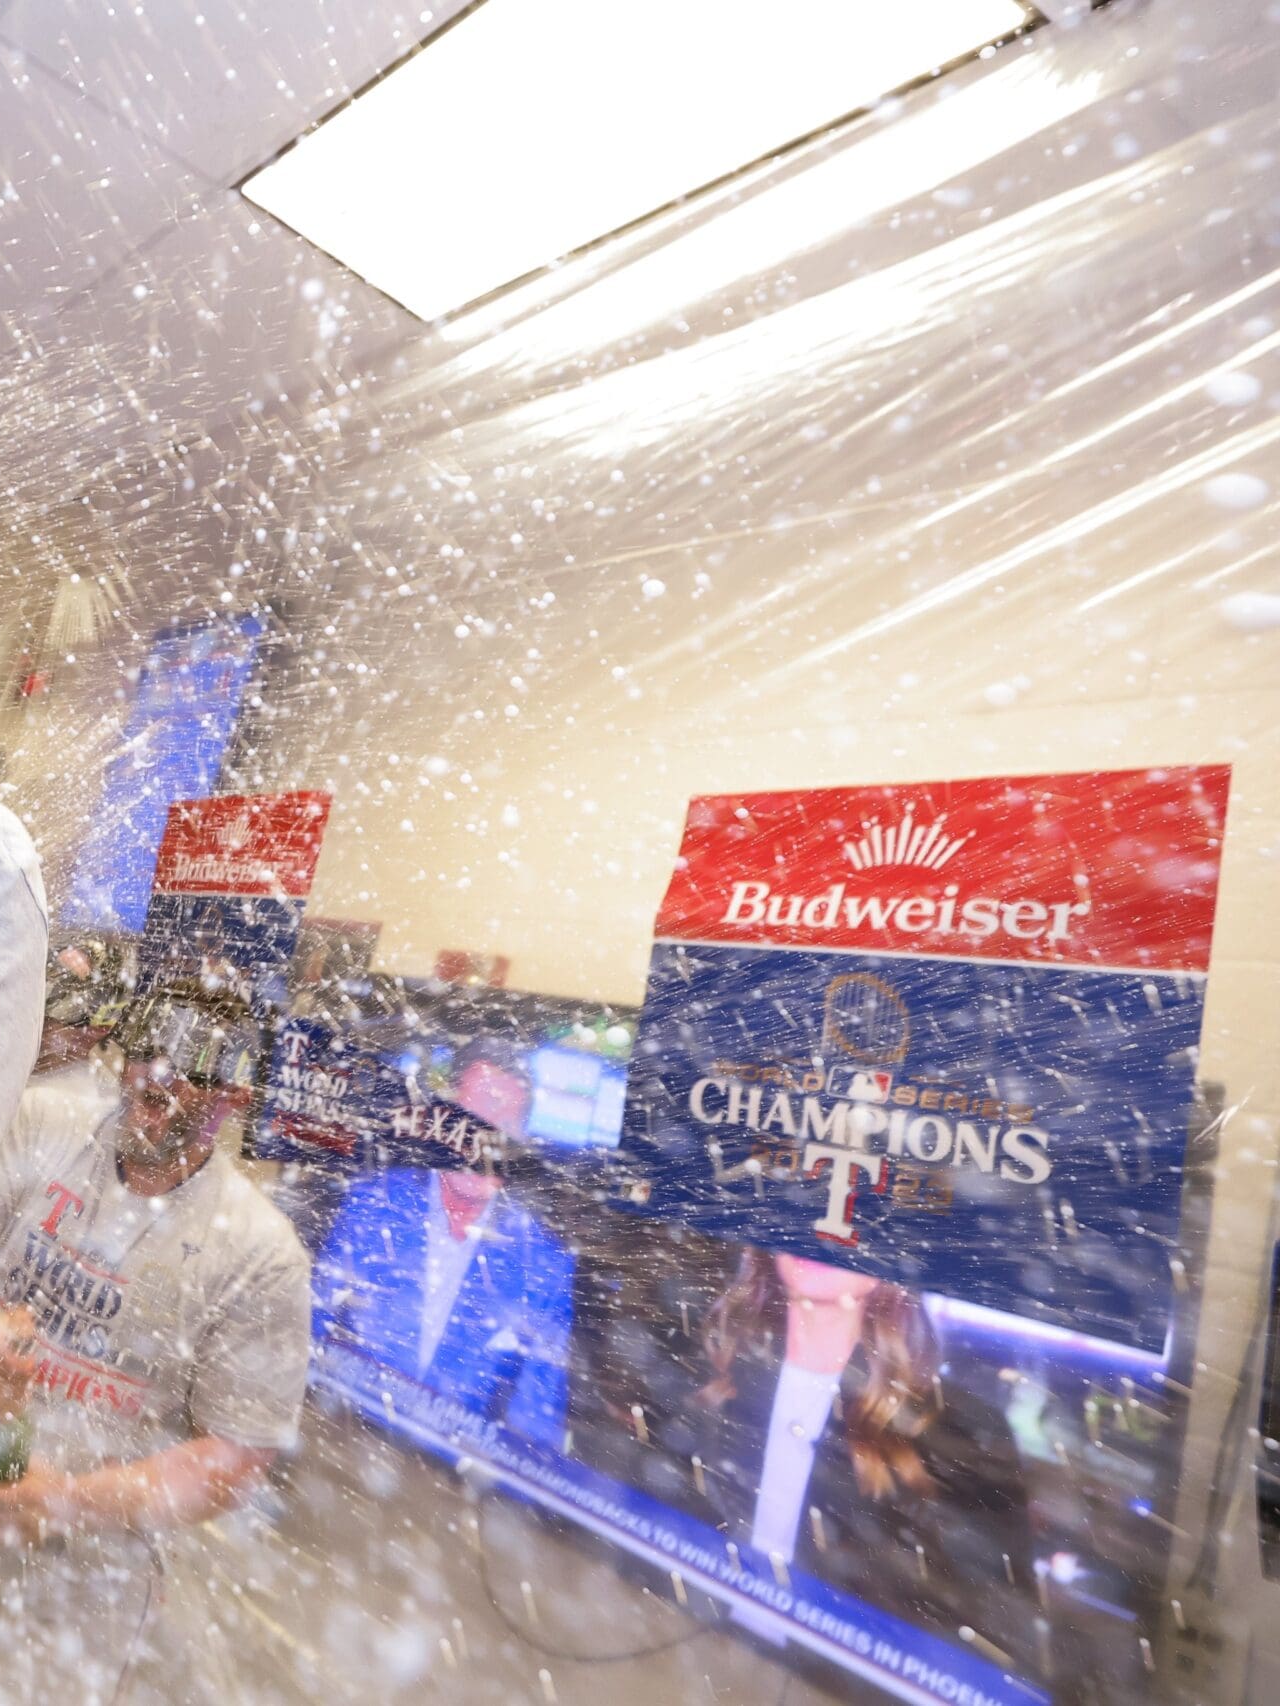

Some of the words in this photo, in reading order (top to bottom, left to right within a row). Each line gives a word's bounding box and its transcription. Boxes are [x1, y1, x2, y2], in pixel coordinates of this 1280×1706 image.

[721, 880, 1091, 944] Budweiser
[283, 1031, 312, 1066] T
[389, 1104, 483, 1164] TEXAS
[689, 1077, 1052, 1185] CHAMPIONS
[893, 1085, 1034, 1124] SERIES
[40, 1179, 83, 1239] T
[803, 1143, 888, 1247] T
[23, 1231, 122, 1320] WORLD
[651, 1526, 679, 1552] TO
[676, 1536, 717, 1575] WIN
[721, 1560, 794, 1613] WORLD
[793, 1599, 873, 1656] SERIES
[872, 1637, 901, 1670] IN
[903, 1652, 1003, 1706] PHOE
